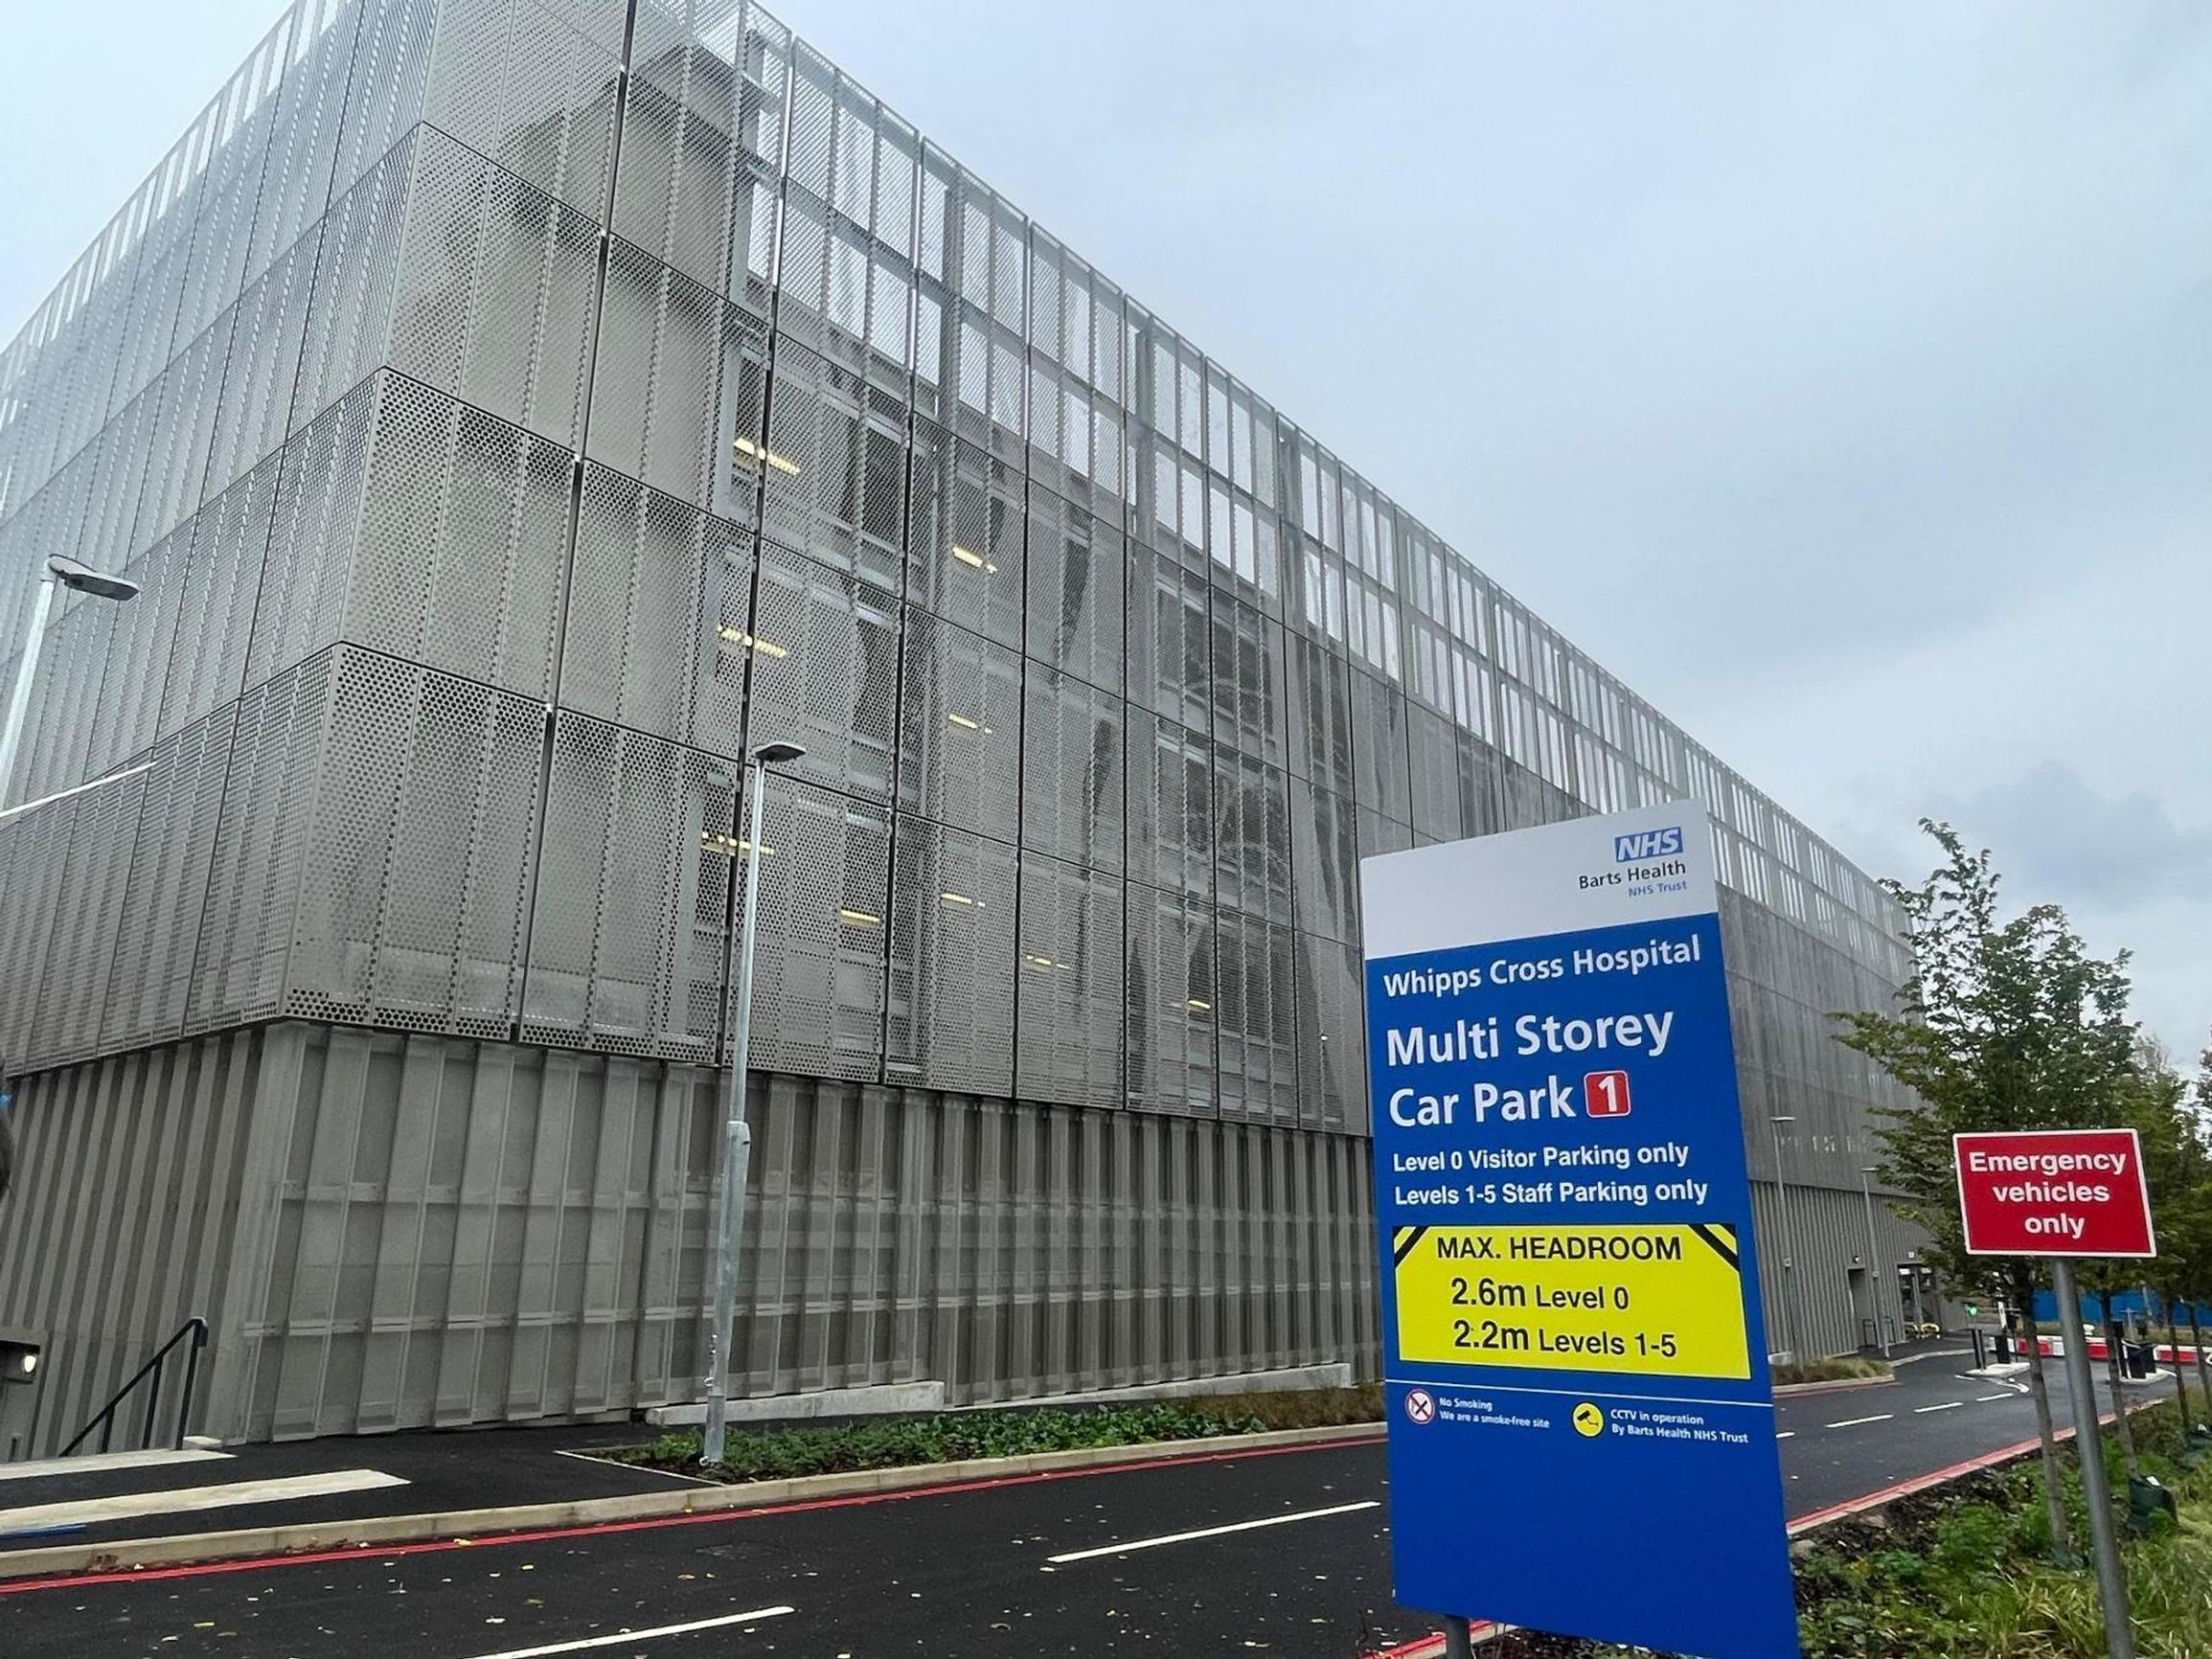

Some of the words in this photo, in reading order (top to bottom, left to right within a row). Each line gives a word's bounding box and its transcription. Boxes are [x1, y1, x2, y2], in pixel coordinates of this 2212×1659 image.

[1617, 828, 1681, 859] NHS
[1579, 872, 1622, 890] Barts
[1628, 861, 1685, 882] Health
[1629, 885, 1654, 898] NHS
[1657, 881, 1687, 894] Trust
[1383, 966, 1481, 997] Whipps
[1490, 957, 1563, 985] Cross
[1574, 934, 1700, 977] Hospital
[1387, 1018, 1499, 1066] Multi
[1516, 1011, 1674, 1057] Storey
[1390, 1088, 1459, 1126] Car
[1474, 1075, 1577, 1122] Park
[1598, 1076, 1617, 1112] 1
[1394, 1153, 1445, 1172] Level
[1450, 1151, 1463, 1170] 0
[1470, 1148, 1537, 1169] Visitor
[1543, 1144, 1629, 1170] Parking
[1637, 1143, 1689, 1167] only
[1969, 1151, 2127, 1175] Emergency
[1396, 1186, 1459, 1205] Levels
[1465, 1185, 1496, 1204] 1-5
[1503, 1183, 1552, 1202] Staff
[1560, 1181, 1648, 1205] Parking
[1655, 1180, 1708, 1204] only
[1993, 1182, 2109, 1202] vehicles
[2025, 1214, 2085, 1239] only
[1437, 1236, 1501, 1260] MAX.
[1510, 1236, 1681, 1260] HEADROOM
[1451, 1278, 1526, 1307] 2.6m
[1536, 1285, 1604, 1308] Level
[1614, 1287, 1629, 1309] 0
[1454, 1321, 1528, 1351] 2.2m
[1539, 1329, 1625, 1354] Levels
[1635, 1333, 1676, 1356] 1-5
[1440, 1398, 1451, 1408] No
[1454, 1398, 1493, 1412] Smoking
[1440, 1411, 1454, 1421] We
[1456, 1414, 1471, 1422] are
[1481, 1414, 1531, 1427] smoke-free
[1533, 1418, 1550, 1427] site
[1611, 1410, 1636, 1421] CCTV
[1639, 1412, 1650, 1422] in
[1653, 1413, 1704, 1427] operation
[1612, 1423, 1625, 1437] By
[1628, 1424, 1653, 1436] Barts
[1656, 1426, 1691, 1439] Health
[1694, 1429, 1718, 1441] NHS
[1720, 1431, 1748, 1443] Trust
